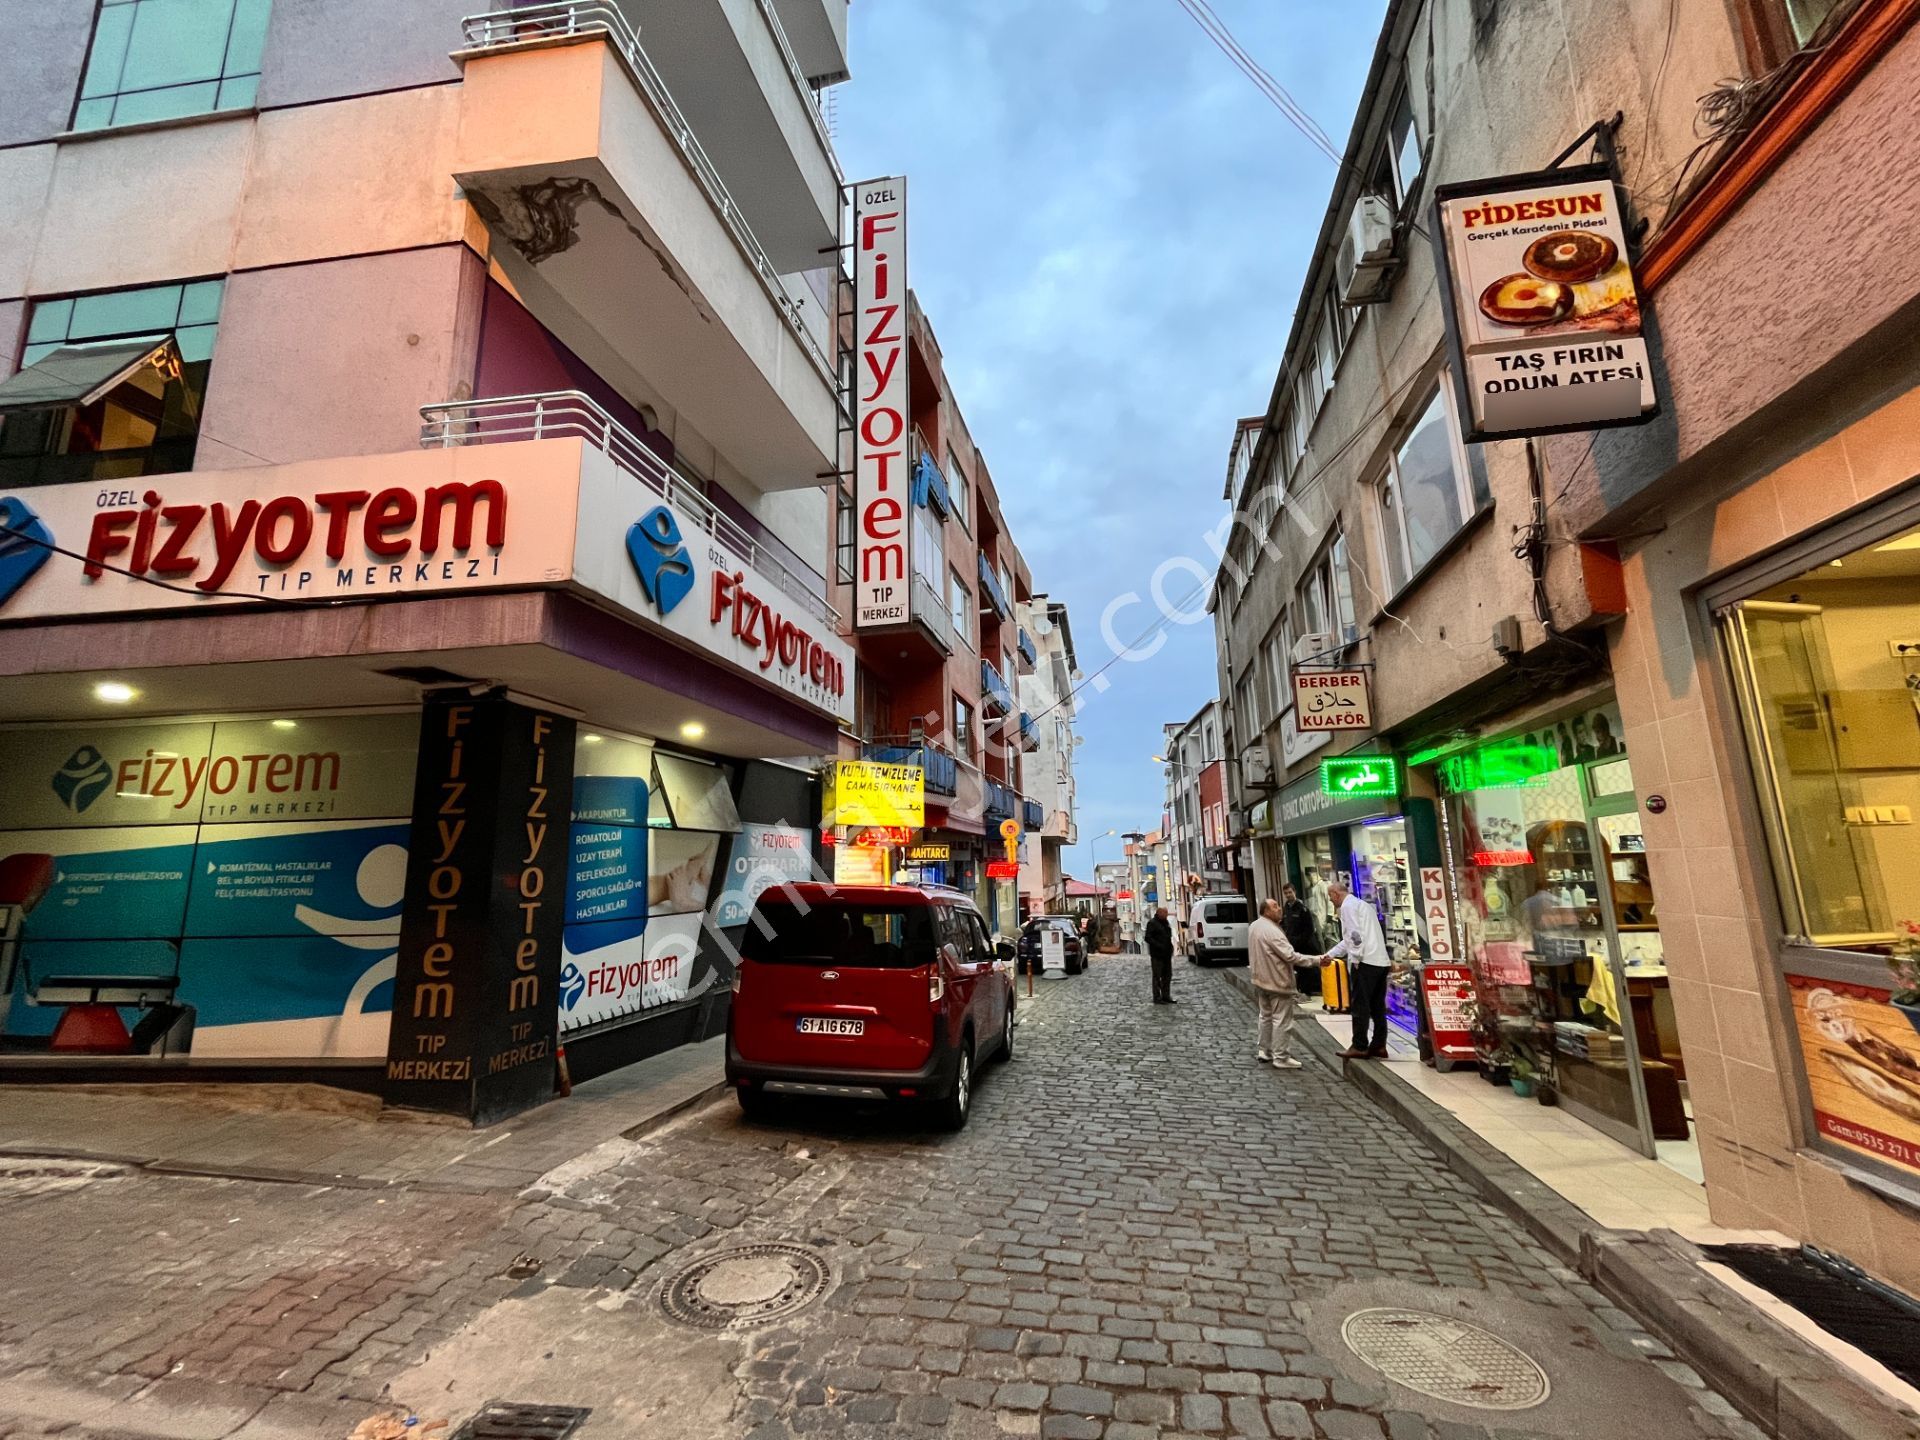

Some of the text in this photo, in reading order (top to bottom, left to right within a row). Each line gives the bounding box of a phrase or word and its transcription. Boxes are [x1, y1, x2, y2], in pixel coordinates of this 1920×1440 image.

[865, 189, 896, 204] ÖZEL
[1463, 193, 1602, 228] PİDESUN
[1468, 217, 1607, 241] Gerçek Karadeniz Pidesi
[1495, 345, 1624, 372] TAŞ FIRIN
[1485, 374, 1559, 394] ODUN
[96, 489, 137, 508] ÖZEL
[708, 547, 729, 572] ÖZEL
[258, 554, 500, 592] TIP MERKEZİ
[872, 587, 892, 603] TIP
[1299, 676, 1361, 688] BERBER
[1308, 690, 1356, 712] حلاق
[1303, 711, 1366, 726] KUAFÖR
[208, 799, 335, 816] TIP MERKEZİ
[577, 808, 627, 820] AKAPUNKTUR
[275, 862, 332, 871] HASTALIKLAR
[576, 852, 596, 863] UZAY
[576, 886, 607, 901] SPORCU
[1423, 870, 1450, 955] KUAFÖ
[1434, 970, 1461, 979] USTA
[510, 1022, 532, 1042] TIP
[802, 1019, 862, 1033] 61 AIG 678
[417, 1035, 445, 1054] TIP
[489, 1035, 550, 1076] MERKEZİ
[387, 1056, 471, 1081] MERKEZİ
[1888, 1142, 1909, 1159] 271
